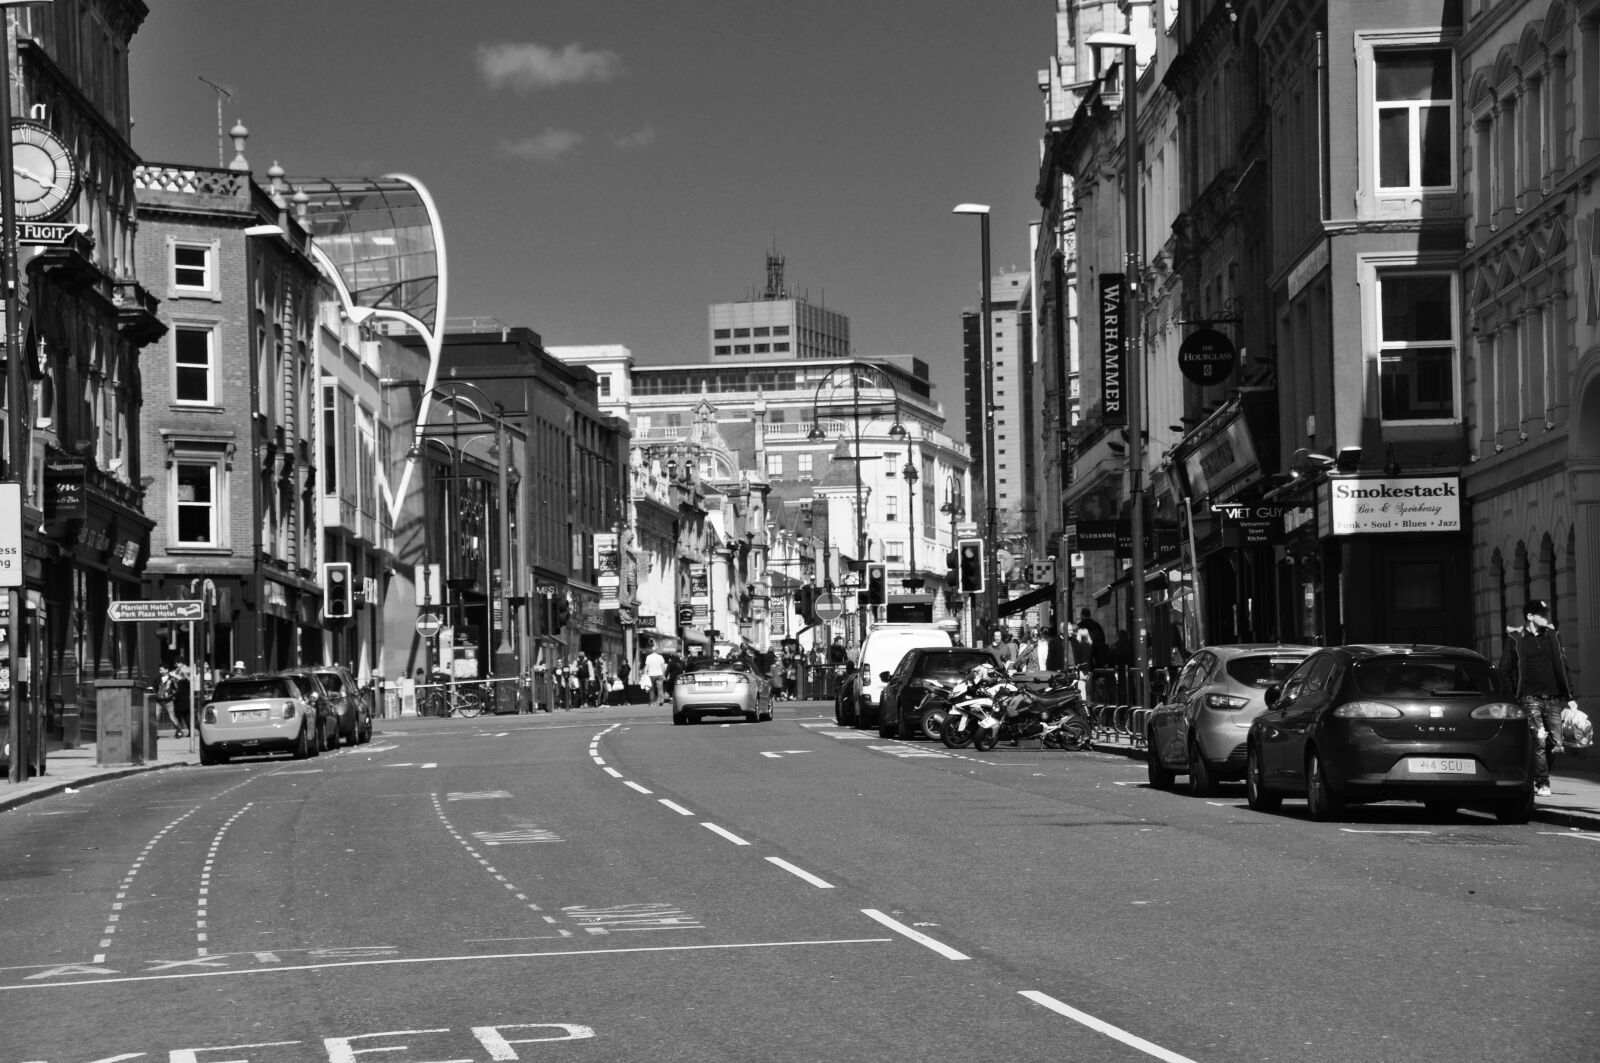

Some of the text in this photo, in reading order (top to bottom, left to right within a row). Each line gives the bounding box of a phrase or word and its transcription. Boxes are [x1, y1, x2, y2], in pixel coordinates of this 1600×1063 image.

[24, 225, 65, 239] FUGIT
[1103, 283, 1120, 413] WARHAMMER
[1336, 482, 1457, 499] Smokestack
[1225, 507, 1284, 519] VIET GUY
[1356, 504, 1374, 514] Bar
[1371, 520, 1391, 529] Soul
[1403, 520, 1427, 528] Blues
[1437, 519, 1458, 528] Jazz
[121, 603, 149, 611] Marriott
[157, 609, 176, 617] Hotel
[1440, 760, 1463, 771] SCU
